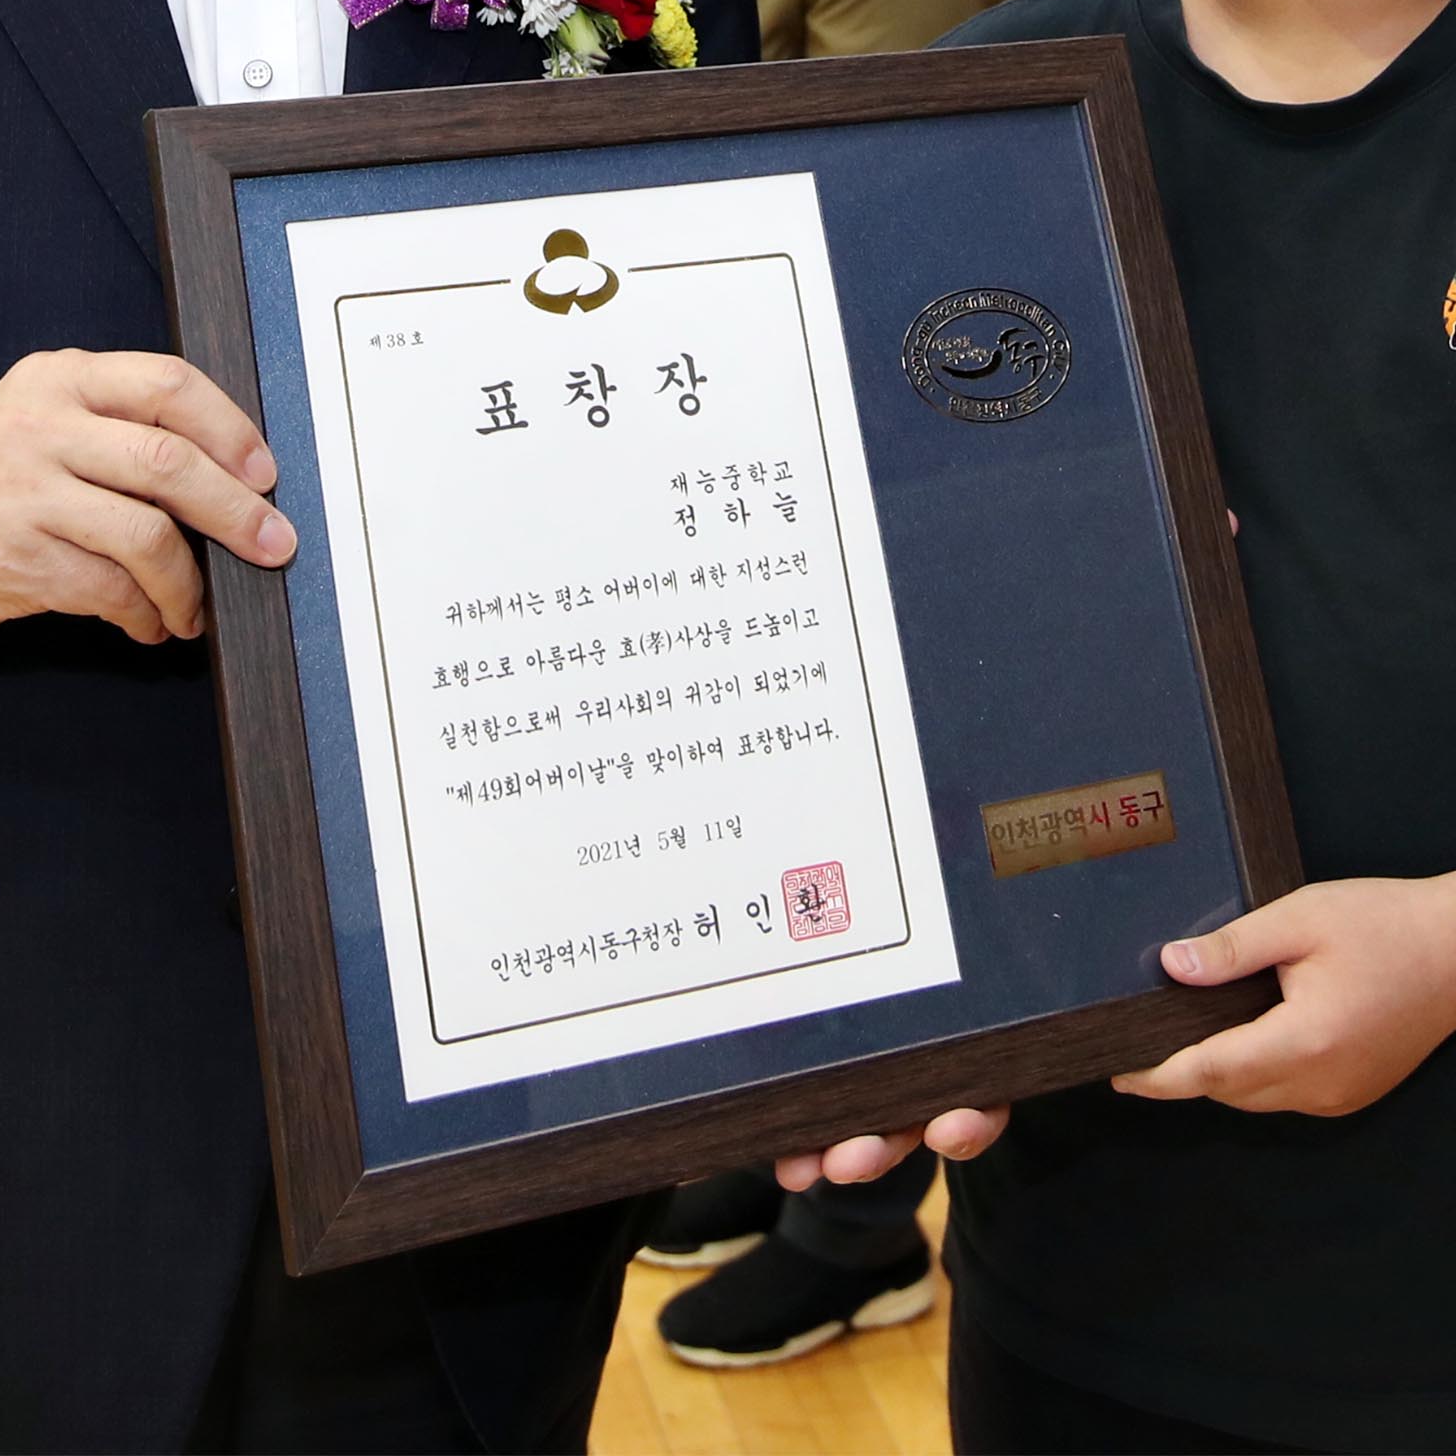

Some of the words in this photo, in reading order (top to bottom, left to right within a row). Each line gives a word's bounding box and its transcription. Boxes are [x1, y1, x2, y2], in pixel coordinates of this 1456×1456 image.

[386, 333, 406, 348] 38
[411, 331, 424, 346] 호
[475, 380, 530, 436] 표
[564, 362, 618, 429] 창
[653, 352, 708, 417] 장
[670, 460, 794, 498] 재능중학교
[674, 503, 697, 538] 정
[723, 497, 752, 529] 하
[772, 491, 799, 523] 늘
[445, 591, 545, 627] 귀하께서는
[554, 585, 595, 612] 평소
[603, 569, 678, 601] 어버이에
[689, 562, 728, 590] 대한
[736, 550, 809, 582] 지성스런
[432, 656, 515, 690] 효행으로
[525, 639, 606, 673] 아름다운
[618, 618, 732, 659] 효(孝)사상을
[744, 607, 820, 639] 드높이고
[440, 704, 562, 751] 실천함으로써
[575, 686, 673, 726] 우리사회의
[684, 674, 741, 706] 귀감이
[753, 660, 828, 695] 되었기에
[646, 736, 724, 775] 맞이하여
[737, 717, 840, 757] 표창합니다.
[576, 833, 641, 866] 2021년
[658, 825, 687, 851] 5월
[704, 814, 743, 842] 11일
[991, 800, 1111, 855] 인천광역시
[1120, 790, 1165, 829] 동구
[490, 917, 684, 983] 인천광역시동구청장
[693, 903, 721, 945] 허
[745, 893, 773, 935] 인
